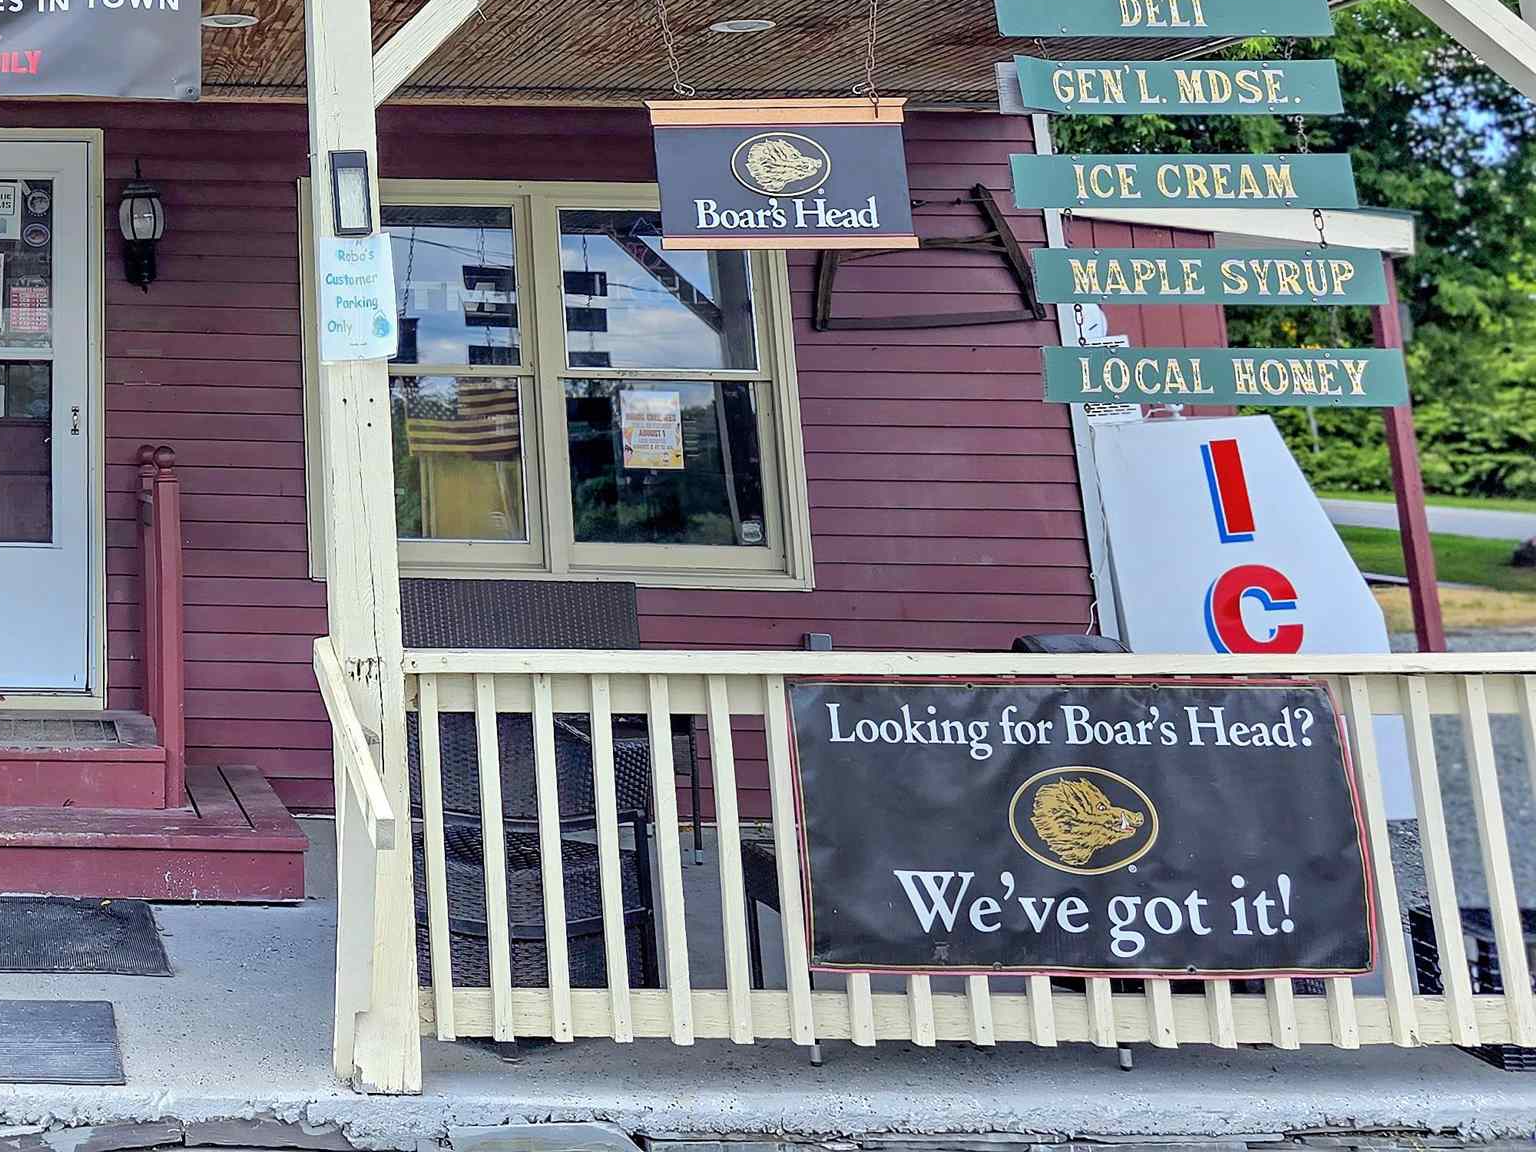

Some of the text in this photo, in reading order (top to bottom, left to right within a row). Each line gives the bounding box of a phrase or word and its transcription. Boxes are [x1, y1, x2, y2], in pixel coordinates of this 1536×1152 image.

[1174, 68, 1302, 105] MDSE.
[1072, 163, 1299, 199] ICE CREAM
[693, 195, 880, 229] Boar's Head
[337, 248, 375, 262] Robo's
[325, 272, 378, 287] Customer
[1068, 258, 1355, 296] MAPLE SYRUP
[336, 296, 378, 311] Parking
[327, 319, 353, 336] Only
[1078, 356, 1369, 396] LOCAL HONEY
[825, 703, 1315, 760] Looking for Boar's Head?
[893, 869, 1296, 958] We've got it!
